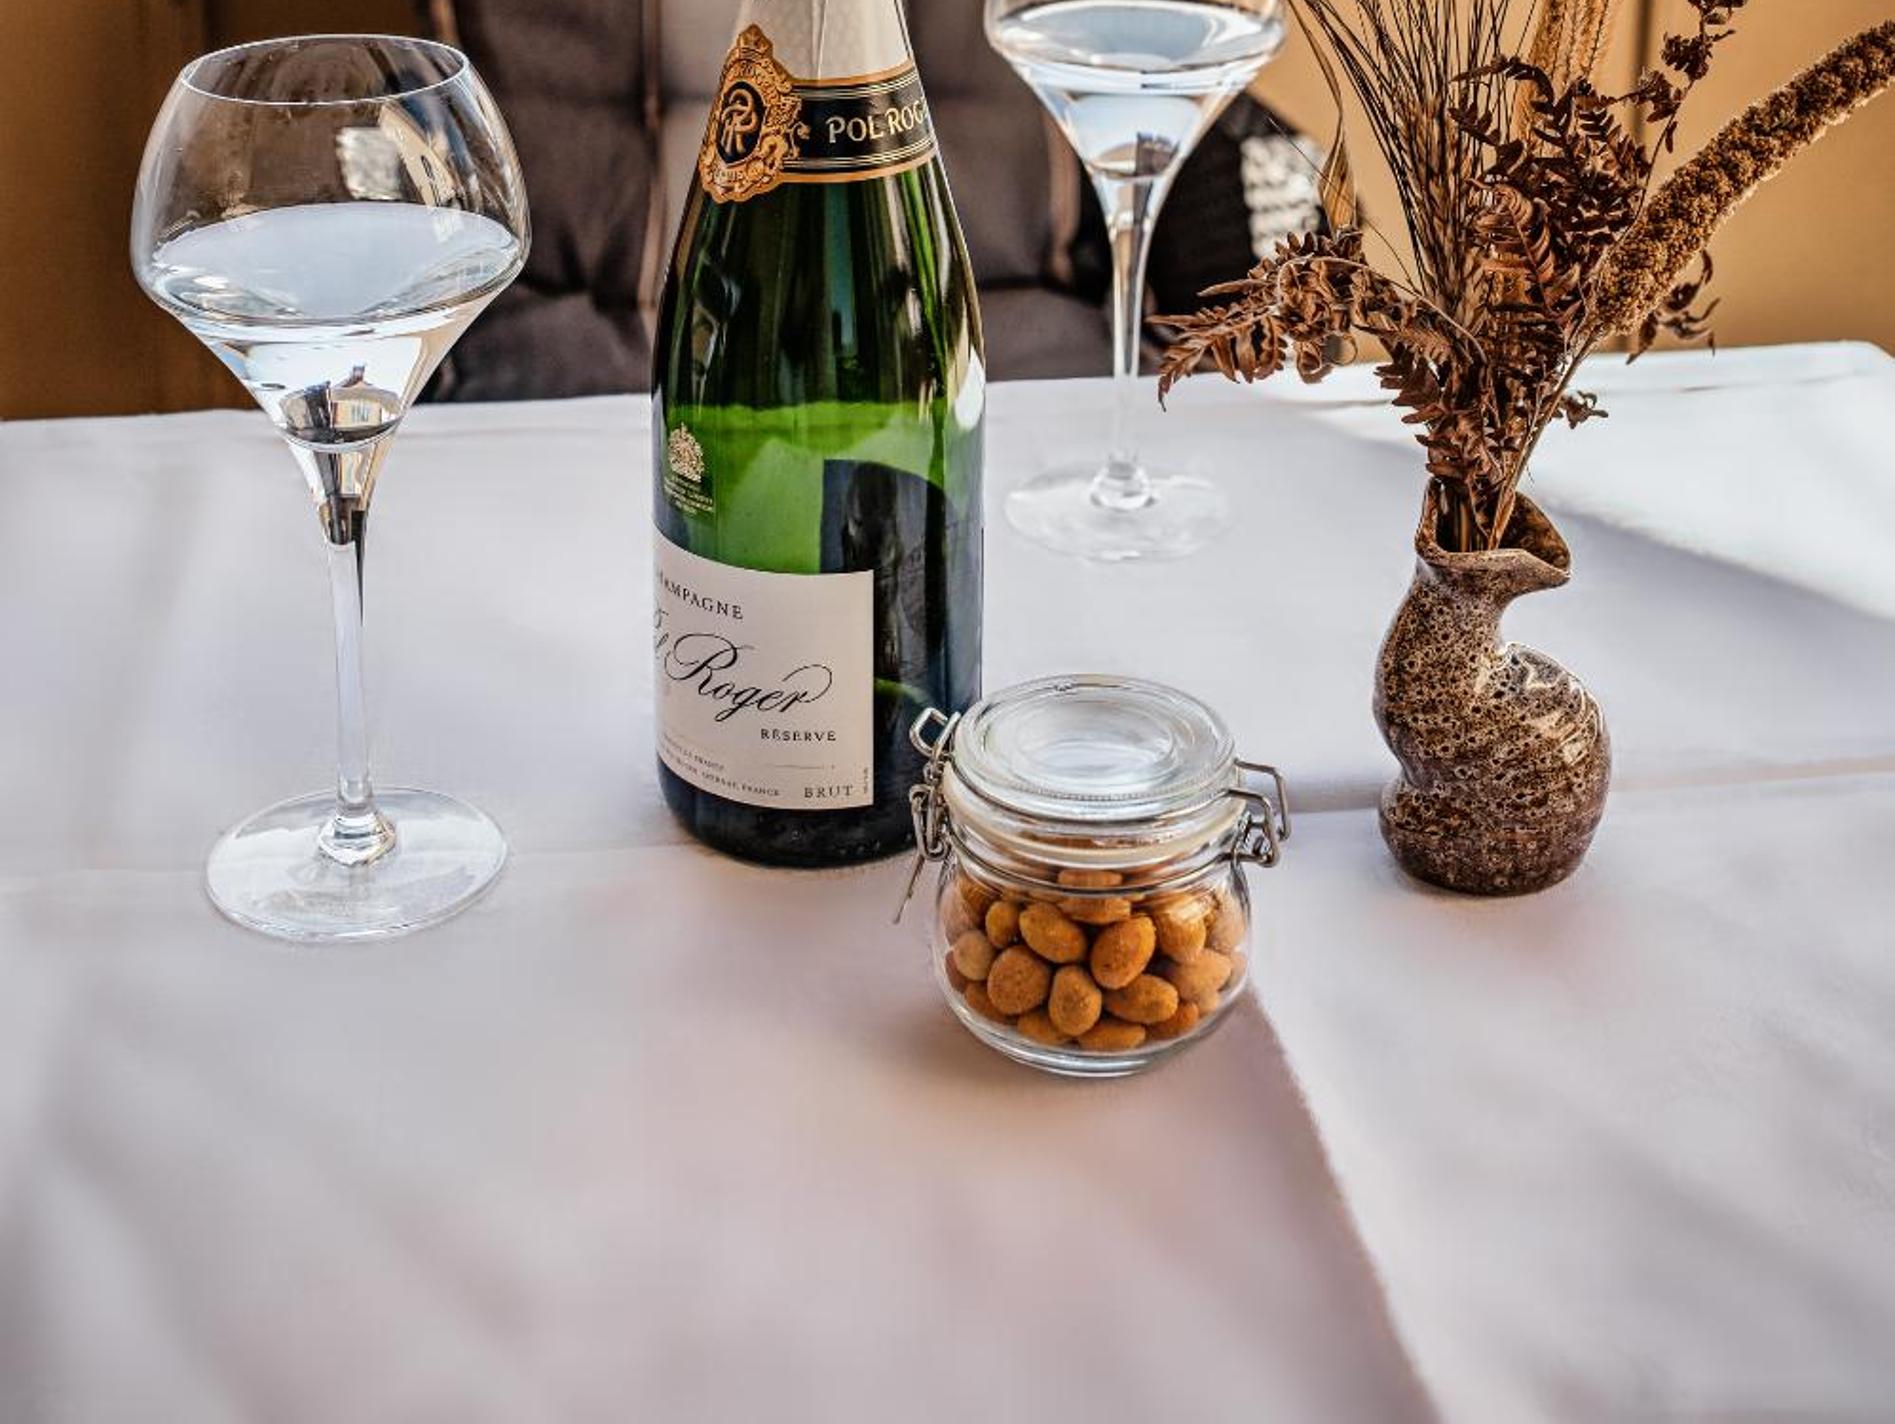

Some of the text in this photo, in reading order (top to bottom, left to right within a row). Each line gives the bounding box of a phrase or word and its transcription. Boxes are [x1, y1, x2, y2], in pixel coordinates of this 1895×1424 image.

[825, 97, 929, 145] POL ROG
[664, 632, 833, 723] Roger
[804, 784, 853, 799] BRUT
